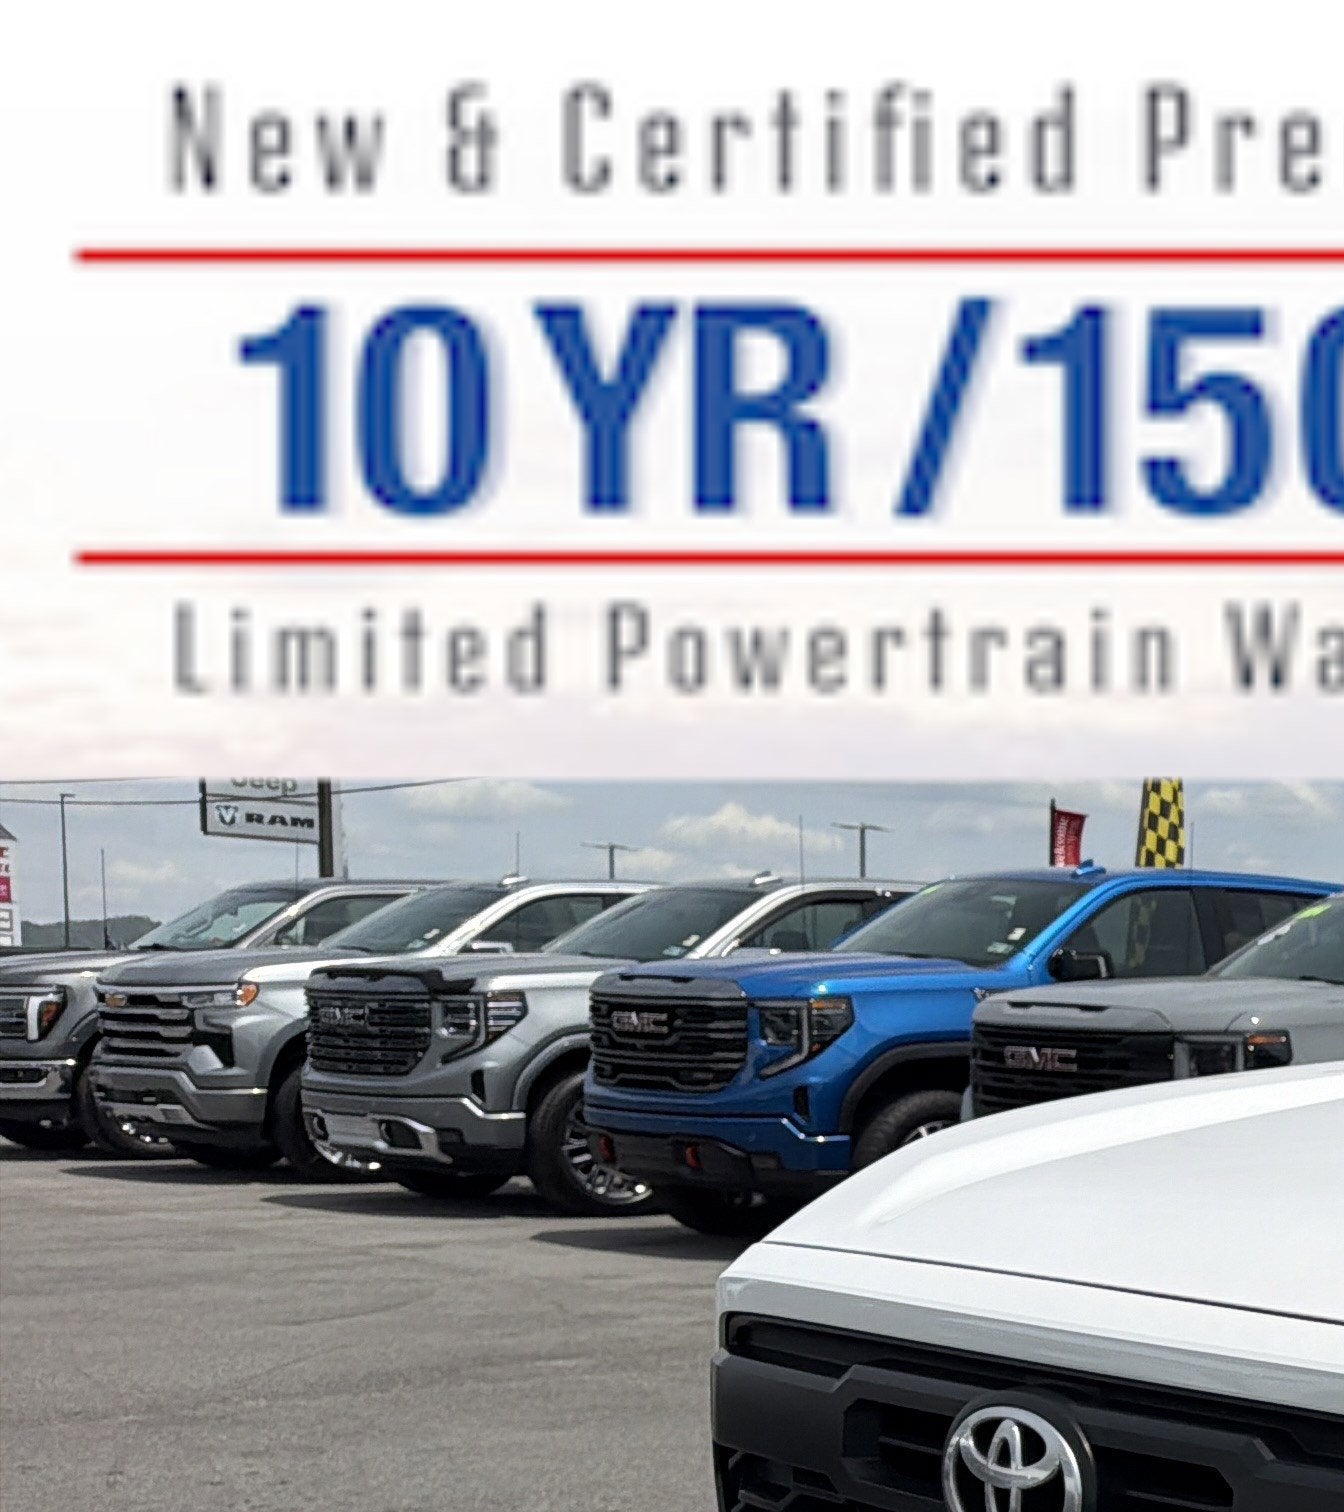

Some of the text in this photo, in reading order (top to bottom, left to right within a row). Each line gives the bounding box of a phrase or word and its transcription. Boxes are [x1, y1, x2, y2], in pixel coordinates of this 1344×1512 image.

[245, 813, 315, 828] RAM
[611, 1011, 669, 1034] GMC
[1003, 1046, 1078, 1072] GMC
